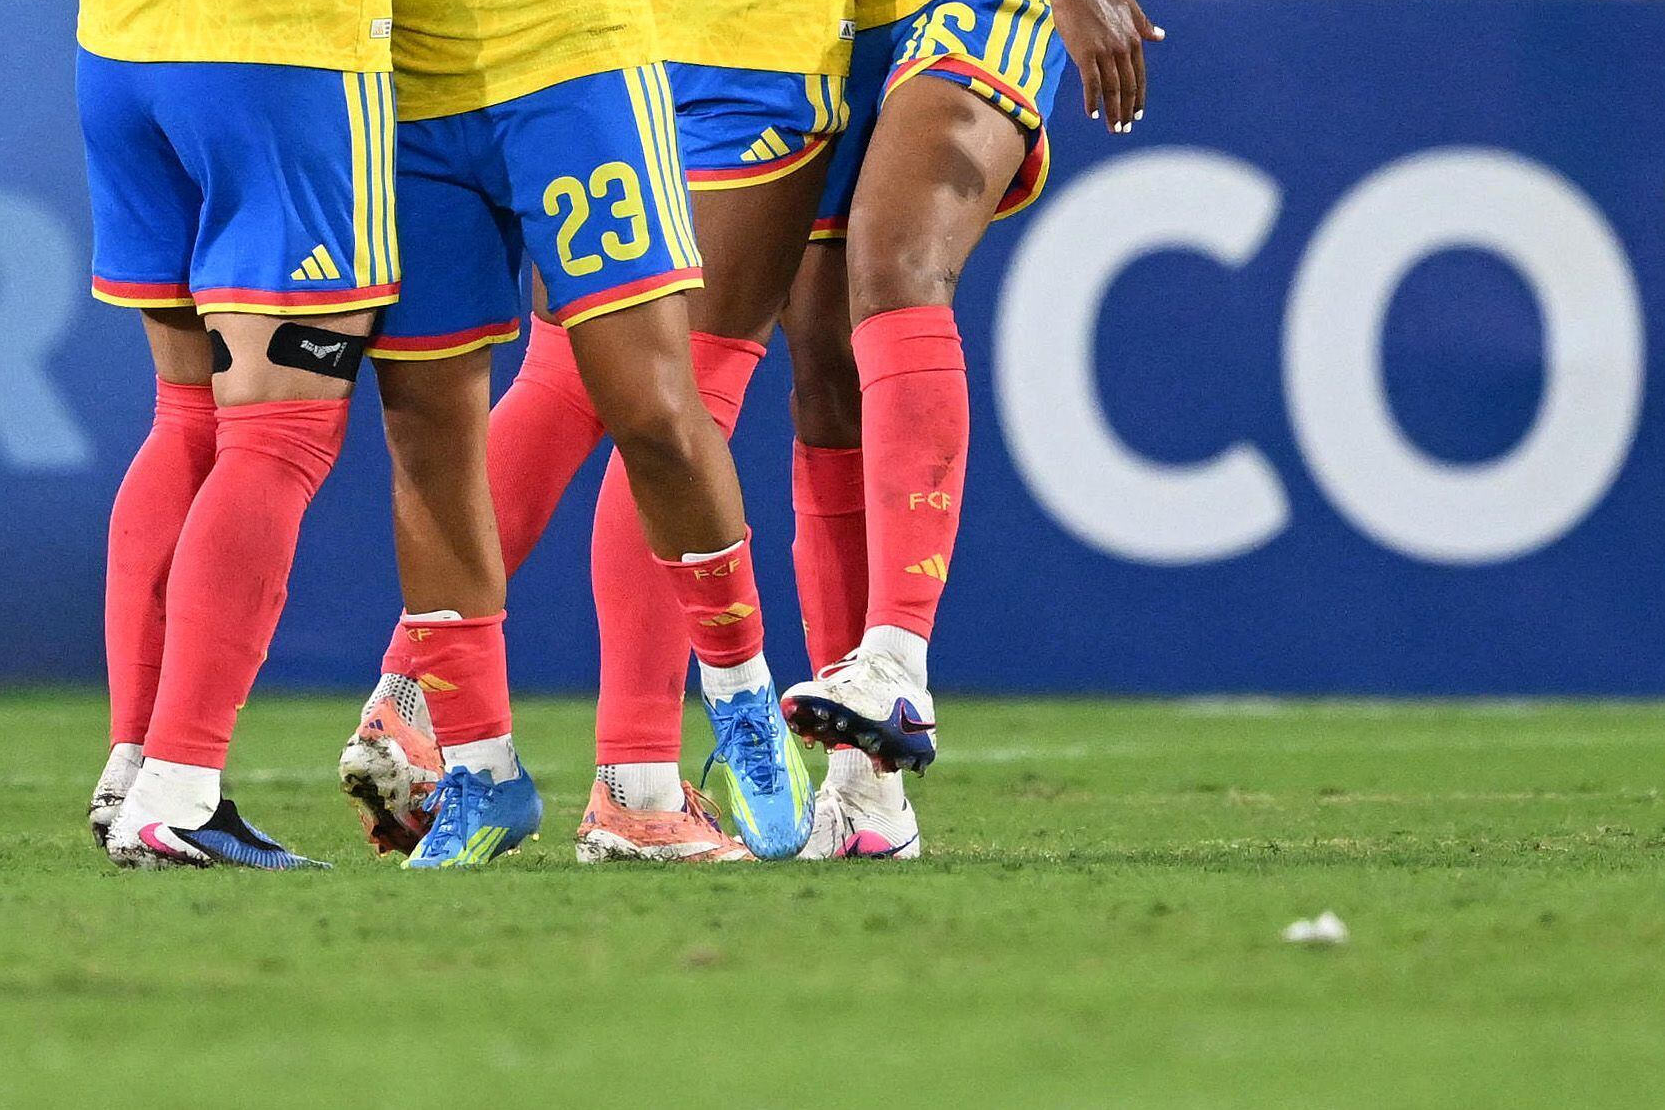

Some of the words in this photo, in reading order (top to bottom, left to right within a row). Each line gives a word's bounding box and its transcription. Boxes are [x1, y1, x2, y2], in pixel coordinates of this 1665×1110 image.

[543, 161, 650, 276] 23
[992, 145, 1647, 567] CO
[909, 491, 952, 511] FCF
[694, 558, 741, 582] FCF
[406, 627, 433, 642] CF
